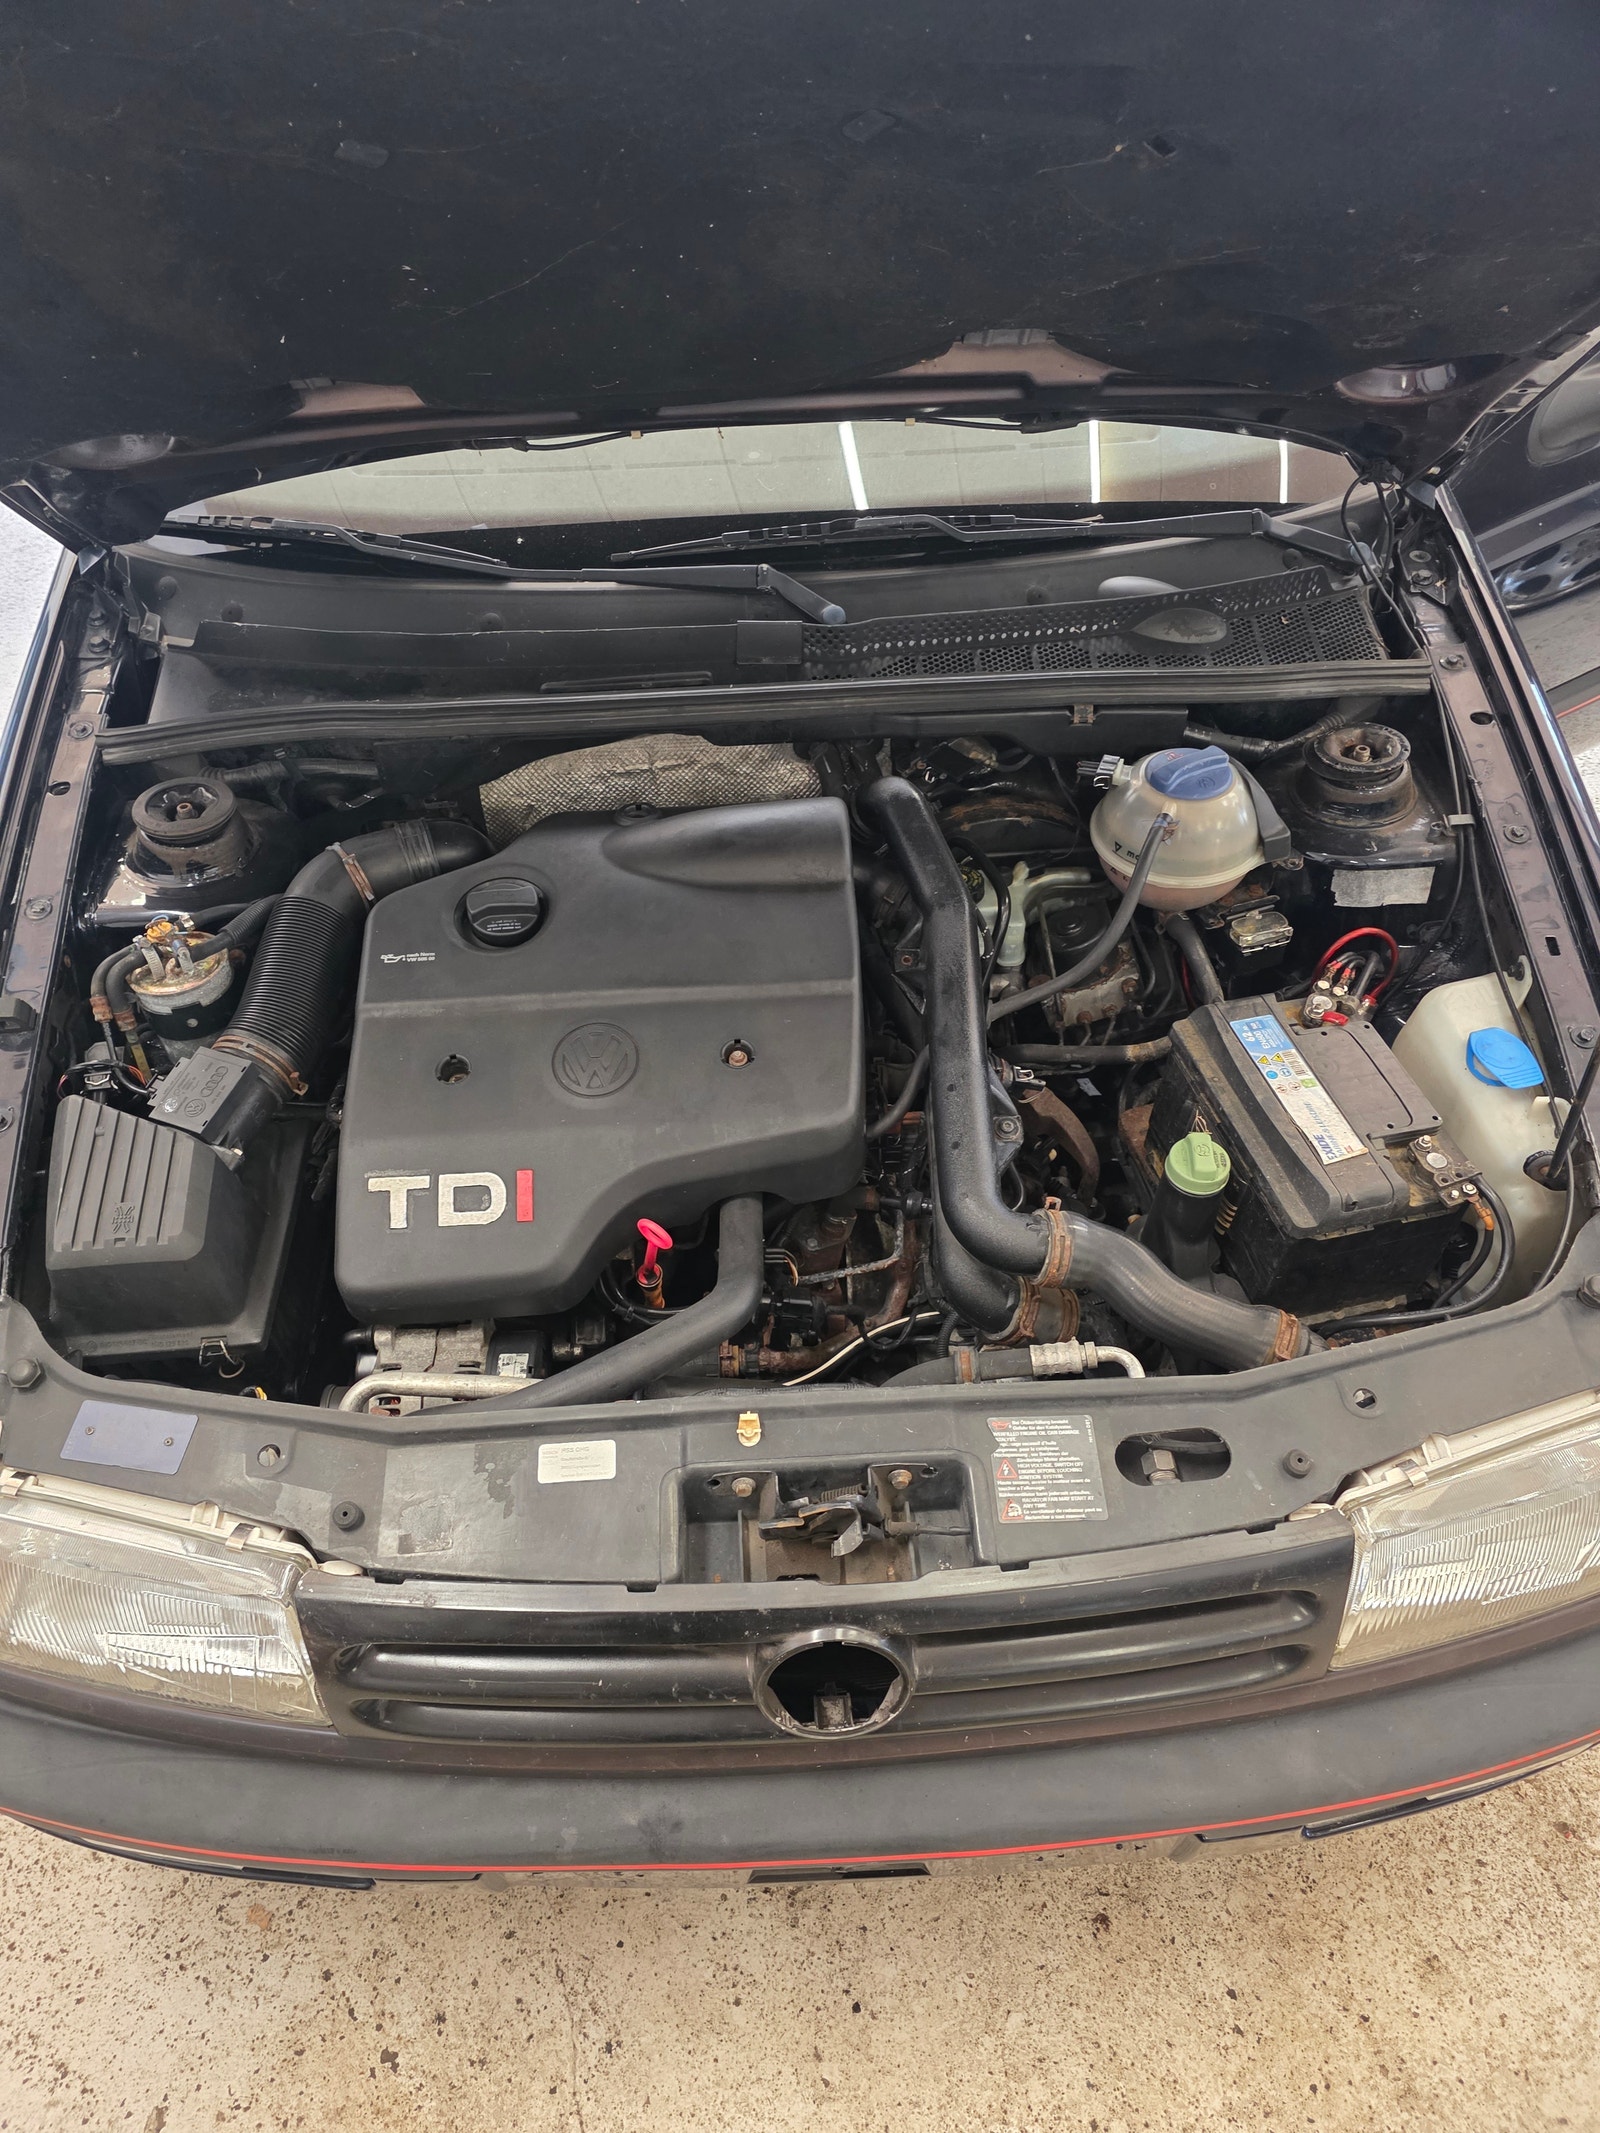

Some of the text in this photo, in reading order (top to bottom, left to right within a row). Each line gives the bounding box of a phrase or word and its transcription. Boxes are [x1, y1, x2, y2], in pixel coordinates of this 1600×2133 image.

[1241, 1031, 1256, 1042] 62
[1312, 1134, 1338, 1160] EXIDE
[367, 1169, 534, 1229] TDI
